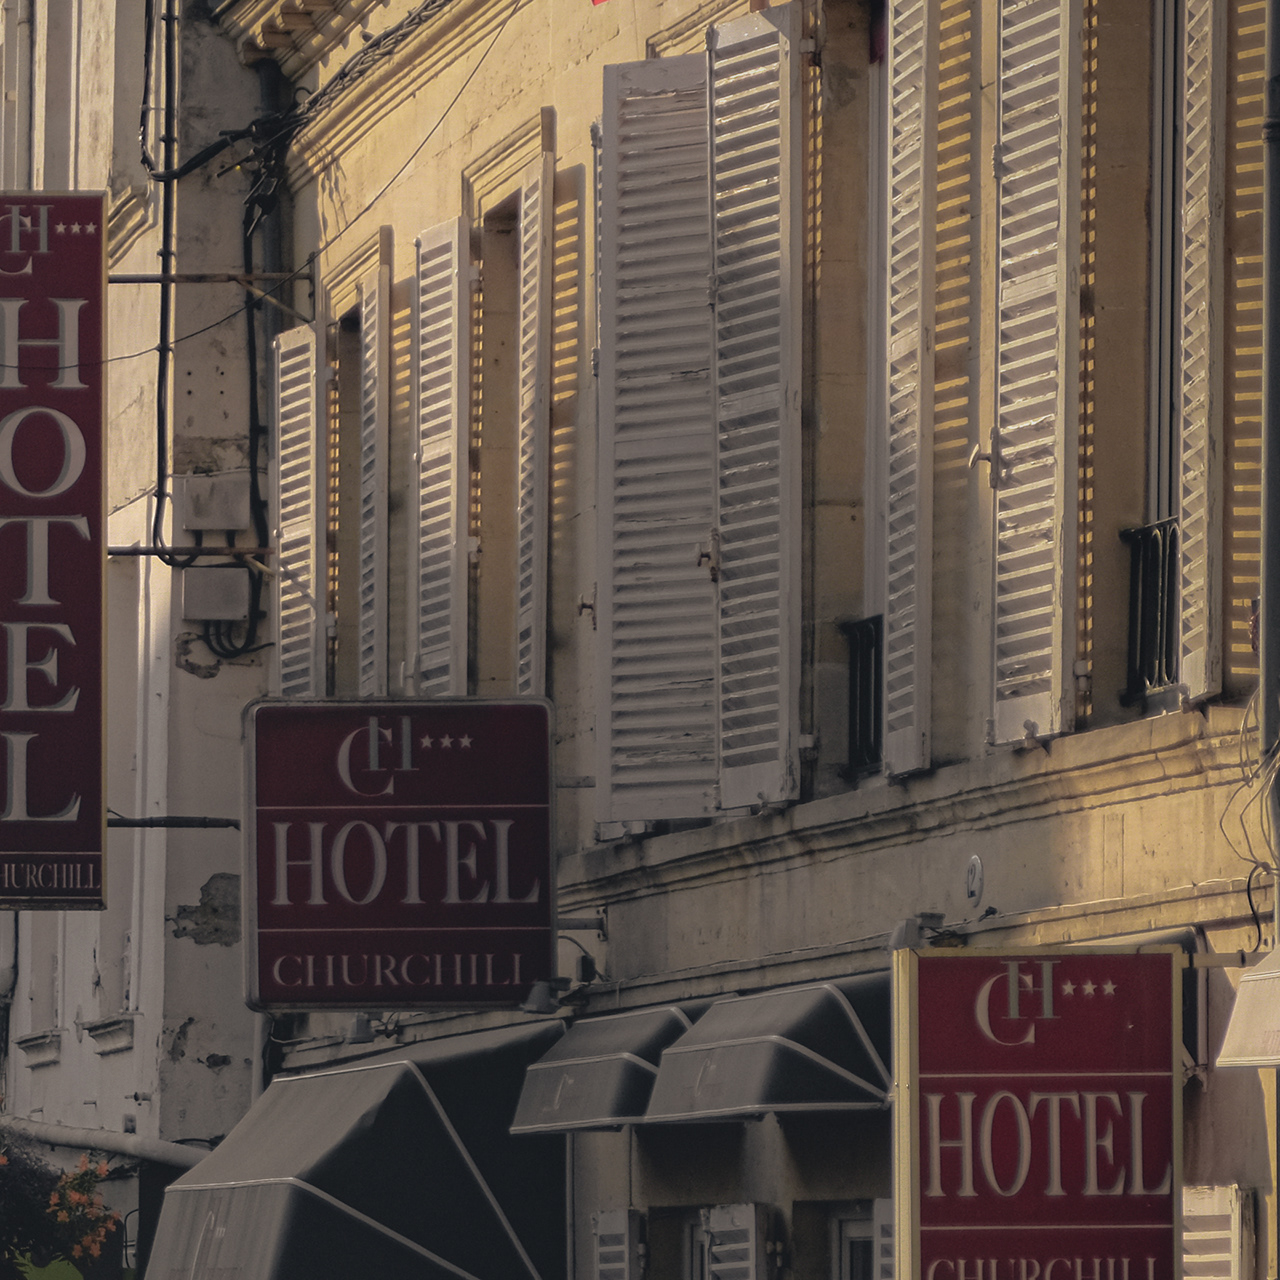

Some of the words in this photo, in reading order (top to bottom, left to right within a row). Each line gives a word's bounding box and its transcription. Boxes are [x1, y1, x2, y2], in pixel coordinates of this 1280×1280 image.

[271, 819, 541, 905] HOTEL
[272, 953, 539, 987] CHURCHILL
[923, 1089, 1172, 1198] HOTEL
